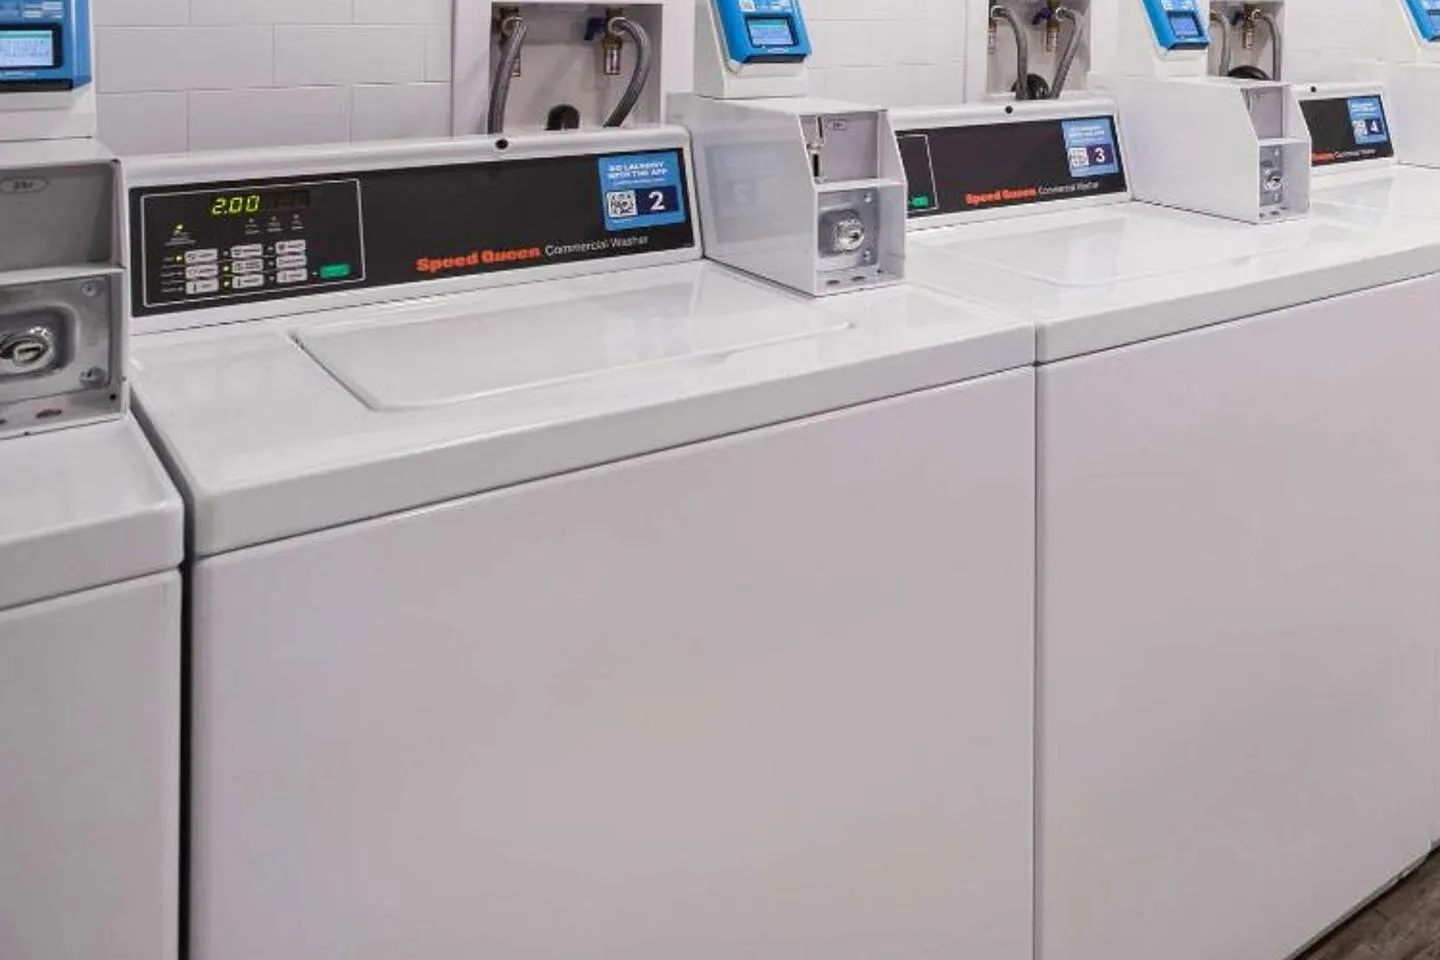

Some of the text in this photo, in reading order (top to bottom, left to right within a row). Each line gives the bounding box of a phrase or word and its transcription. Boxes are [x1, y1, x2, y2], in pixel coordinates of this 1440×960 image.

[1094, 147, 1106, 163] 3
[211, 195, 260, 215] 2.00
[649, 191, 666, 210] 2
[416, 235, 649, 273] Speed Queen Commercial Washer
